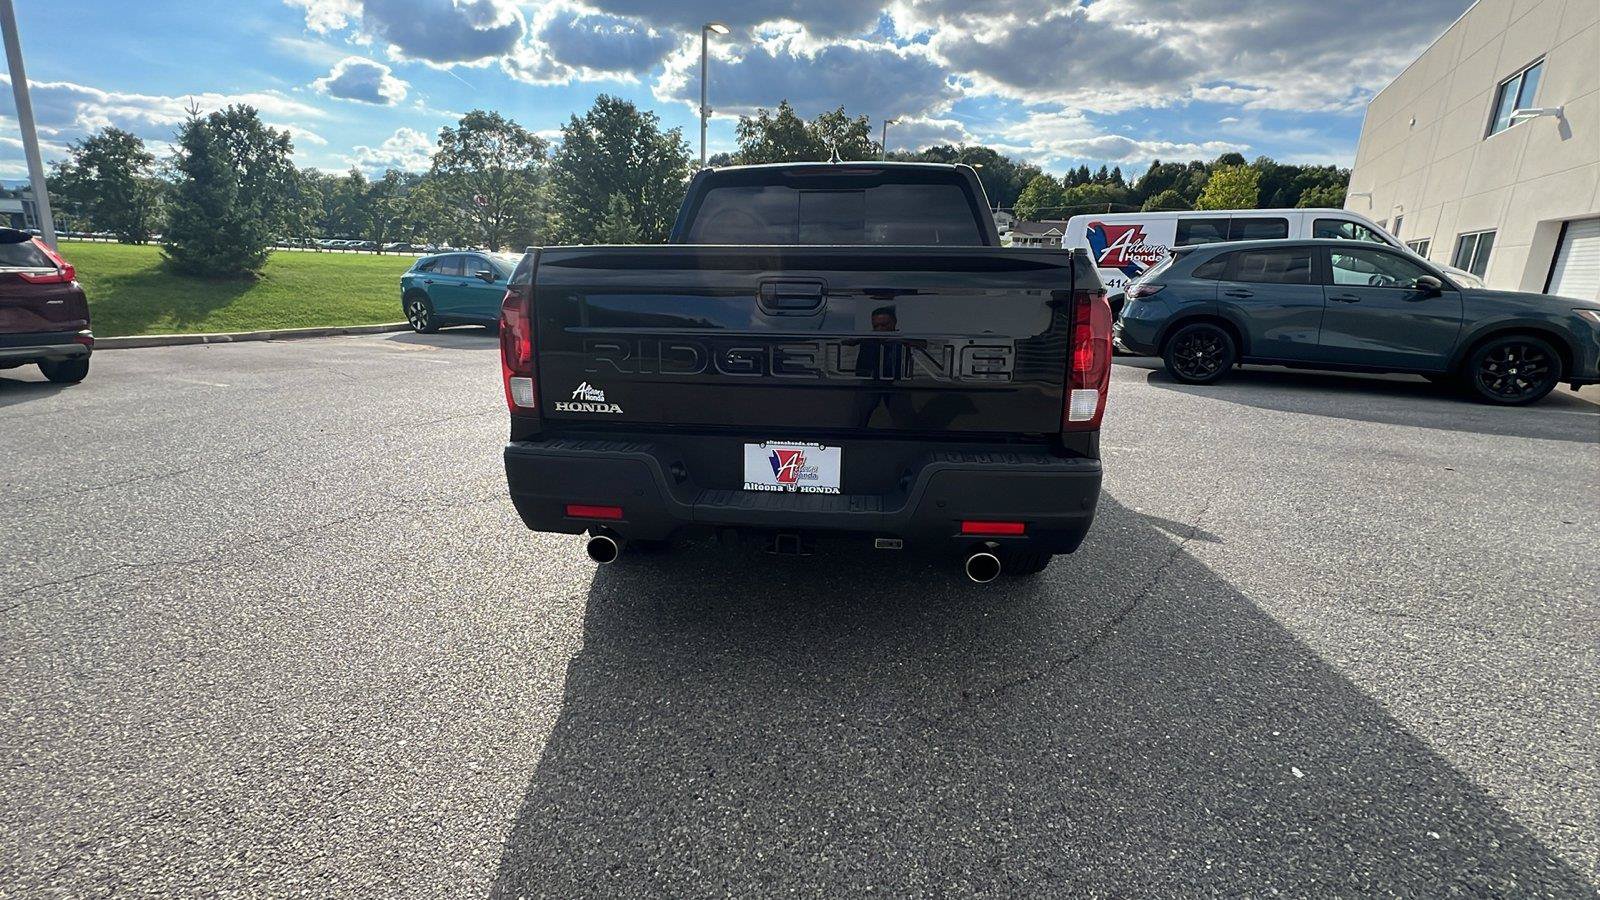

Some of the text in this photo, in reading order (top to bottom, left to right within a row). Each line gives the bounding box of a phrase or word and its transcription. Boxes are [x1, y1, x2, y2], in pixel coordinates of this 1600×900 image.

[1098, 228, 1165, 262] Altoona
[1125, 253, 1163, 262] Honda
[583, 338, 1015, 383] RIDGELINE
[585, 394, 605, 402] Honda
[554, 401, 624, 413] HONDA
[743, 482, 840, 494] Altoona HONDA
